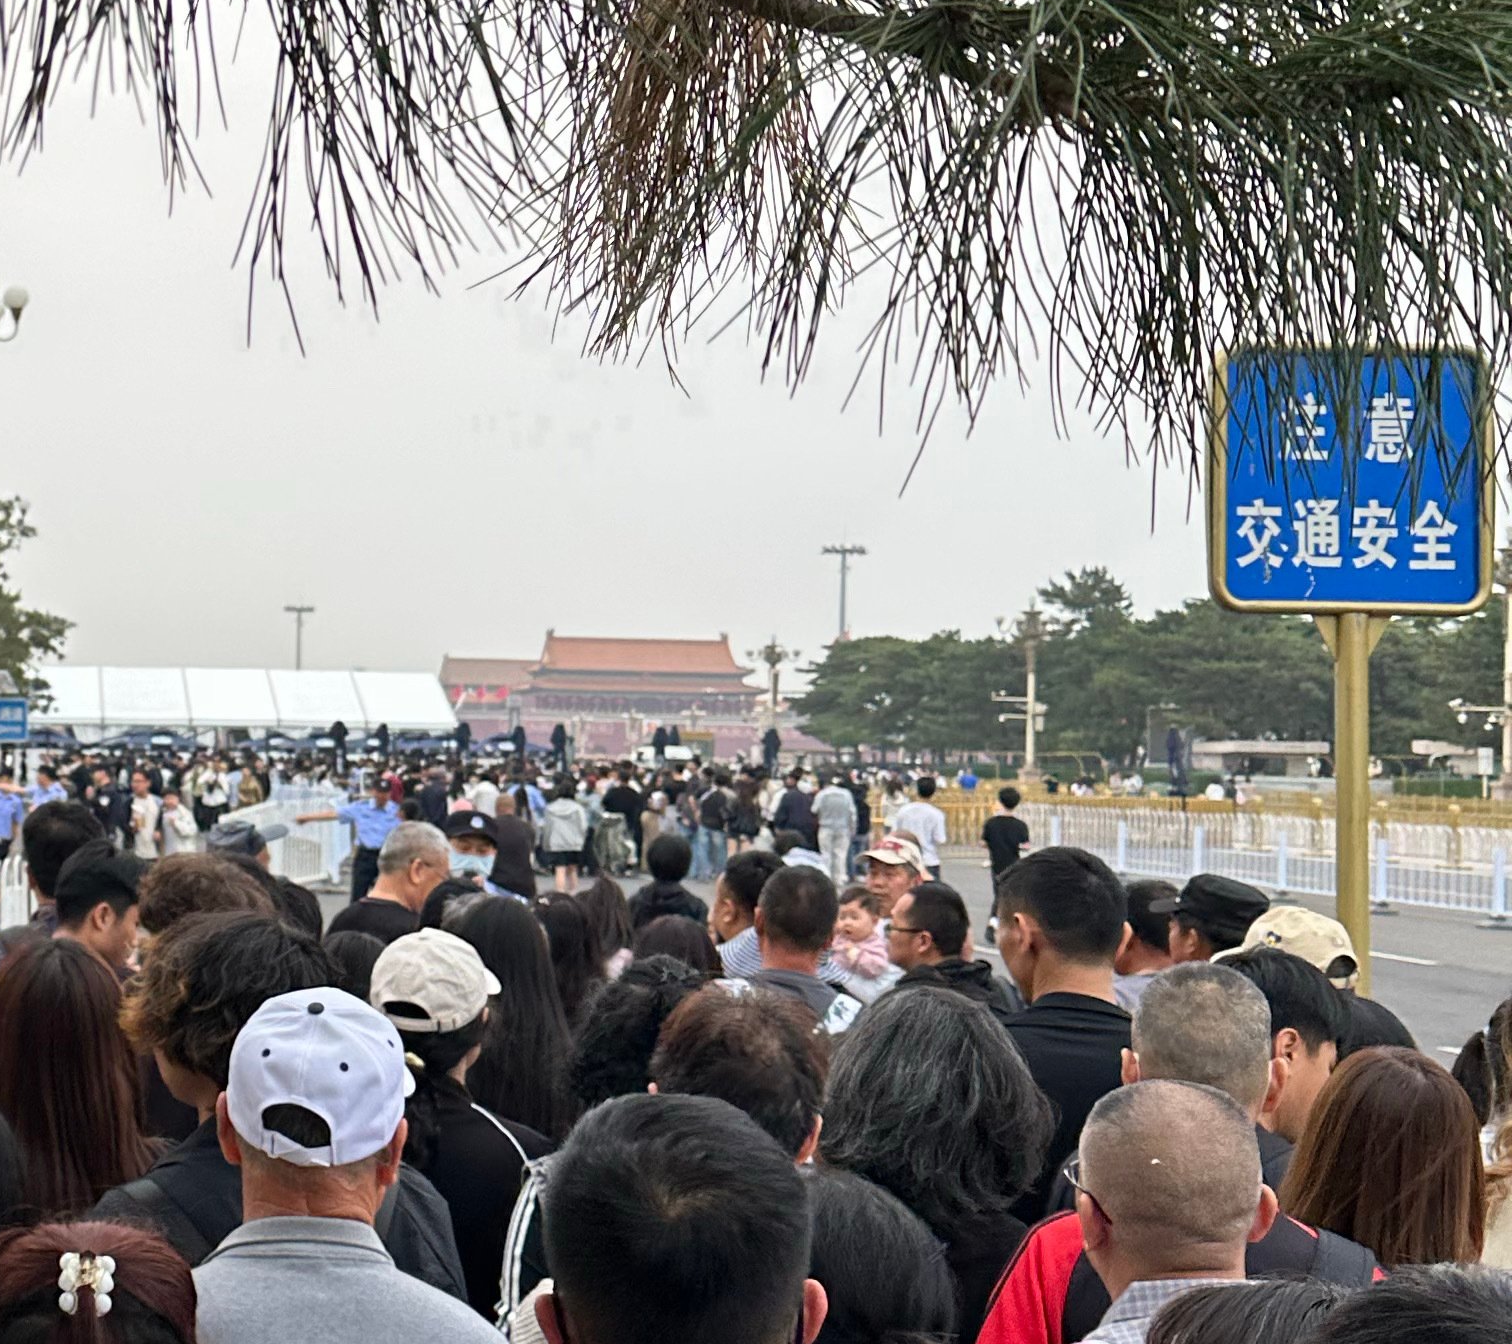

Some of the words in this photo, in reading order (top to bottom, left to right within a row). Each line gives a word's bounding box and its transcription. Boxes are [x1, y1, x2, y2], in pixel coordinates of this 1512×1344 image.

[1278, 392, 1414, 463] 注意
[1235, 498, 1458, 570] 交通安全
